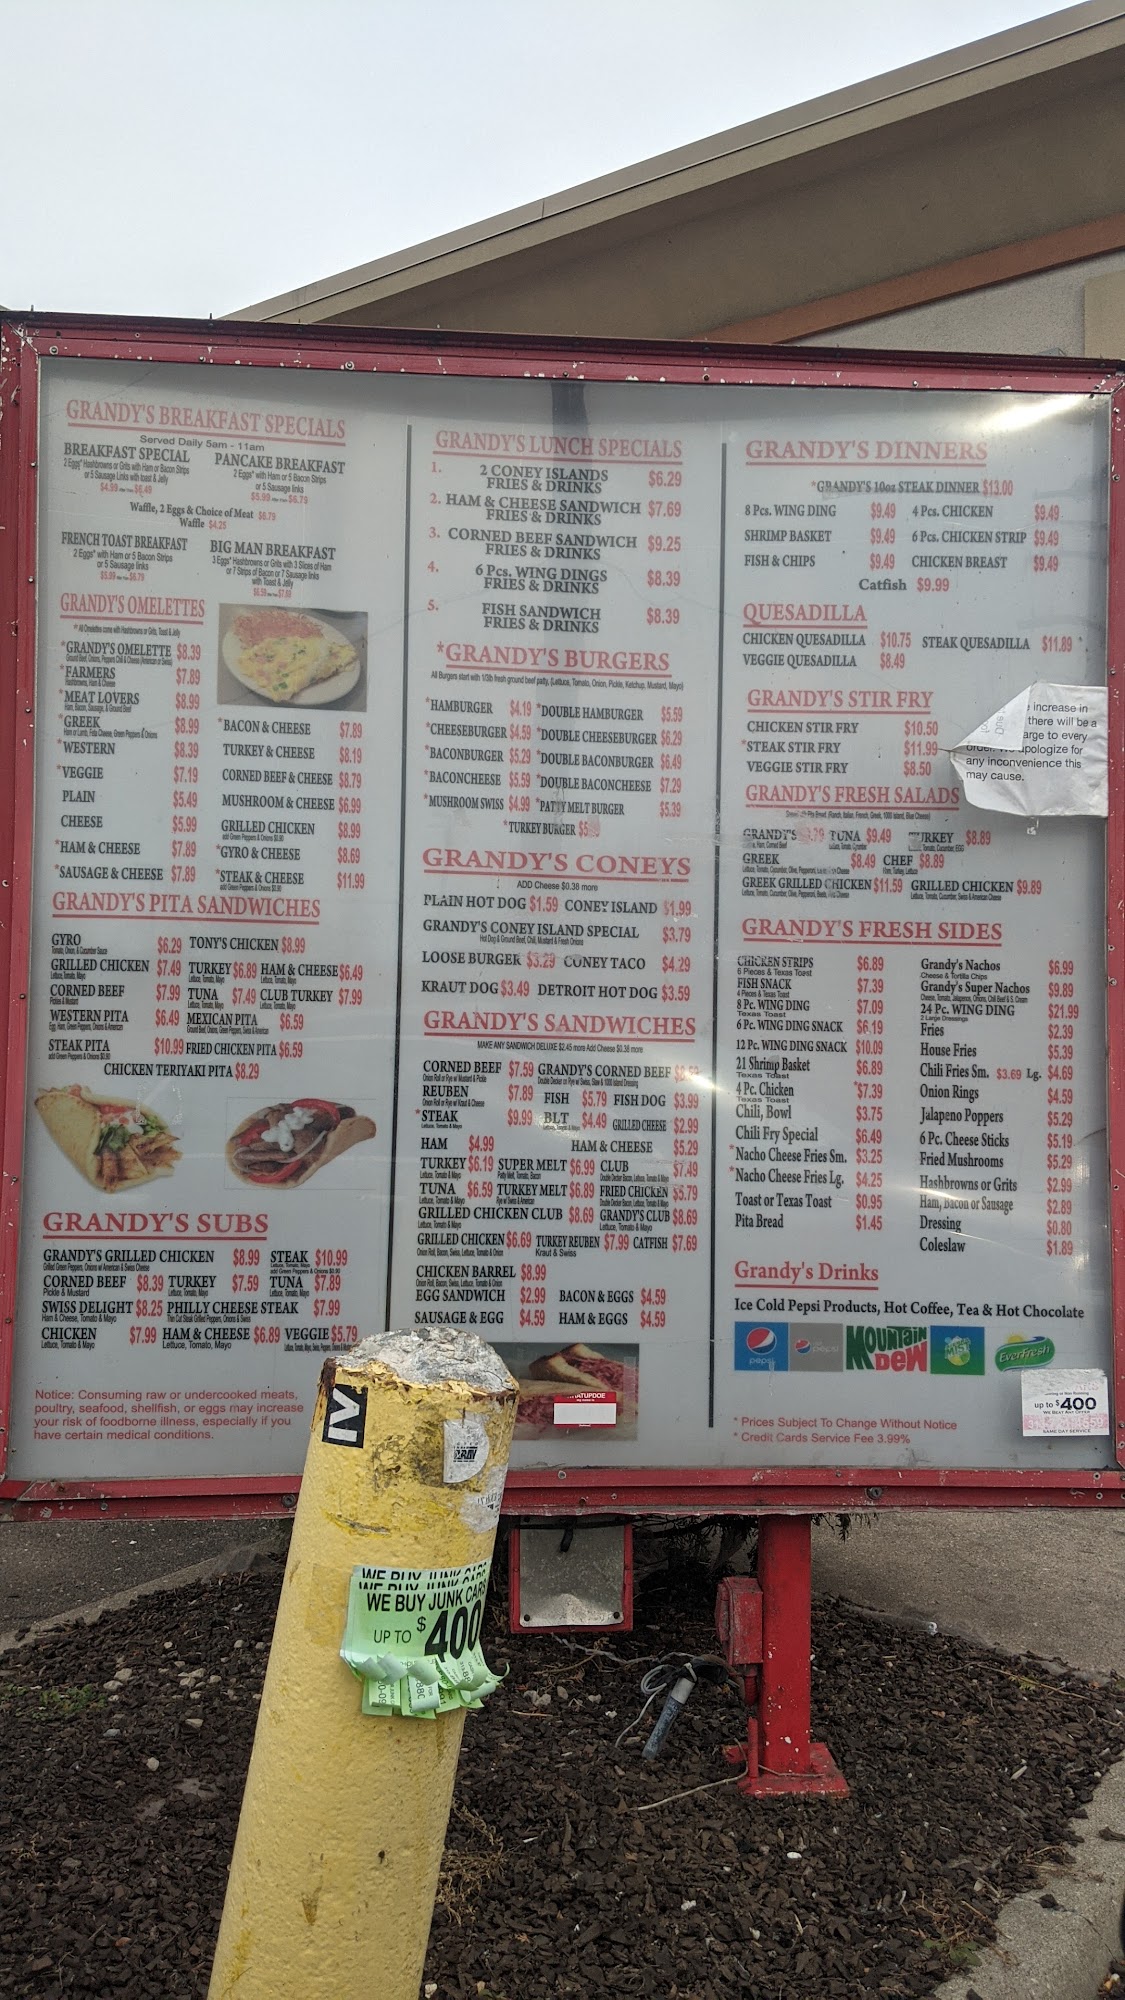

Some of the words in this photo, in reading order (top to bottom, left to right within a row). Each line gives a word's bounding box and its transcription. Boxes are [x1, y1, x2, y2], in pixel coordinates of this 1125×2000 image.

[66, 399, 155, 424] GRANDY'S
[159, 405, 262, 433] BREAKFAST
[265, 412, 346, 439] SPECIALS
[64, 442, 135, 460] BREAKFAST
[139, 447, 190, 464] SPECIAL
[435, 430, 526, 453] GRANDY'S
[530, 435, 594, 456] LUNCH
[598, 438, 683, 458] SPECIALS
[745, 440, 869, 460] GRANDY'S
[875, 441, 988, 461] DINNERS
[215, 452, 272, 470] PANCAKE
[276, 456, 346, 475] BREAKFAST
[480, 464, 488, 476] 2
[491, 464, 543, 479] CONEY
[546, 467, 609, 482] ISLANDS
[648, 469, 682, 488] $6.29
[445, 493, 481, 508] HAM
[485, 496, 495, 508] &
[498, 496, 557, 512] CHEESE
[559, 499, 641, 515] SANDWICH
[648, 500, 682, 518] $7.69
[744, 529, 787, 542] SHRIMP
[789, 529, 832, 542] BASKET
[870, 527, 896, 545] $9.49
[858, 578, 907, 591] Catfish
[917, 577, 950, 593] $9.99
[60, 592, 125, 615] GRANDY'S
[128, 595, 205, 618] OMELETTES
[743, 603, 867, 626] QUESADILLA
[922, 636, 958, 649] STEAK
[959, 637, 1030, 652] QUESADILLA
[1042, 635, 1073, 653] $11.89
[747, 689, 843, 708] GRANDY'S
[848, 690, 892, 709] STIR
[896, 691, 934, 709] FRY
[1033, 702, 1077, 713] increase
[1079, 704, 1088, 713] in
[747, 721, 803, 734] CHICKEN
[806, 722, 834, 734] STIR
[835, 722, 859, 734] FRY
[904, 720, 939, 737] $10.50
[1028, 716, 1054, 726] there
[1057, 716, 1074, 726] will
[1076, 718, 1089, 727] be
[1048, 731, 1058, 739] to
[1061, 732, 1088, 742] every
[223, 743, 265, 757] TURKEY
[266, 745, 274, 758] &
[275, 745, 315, 760] CHEESE
[339, 746, 362, 764] $8.19
[1071, 745, 1083, 755] for
[966, 757, 985, 767] any
[987, 757, 1062, 768] inconvenience
[1065, 759, 1081, 769] this
[966, 771, 988, 781] may
[990, 772, 1025, 782] cause.
[221, 819, 266, 833] GRILLED
[268, 821, 315, 836] CHICKEN
[338, 821, 361, 840] $8.99
[422, 848, 568, 872] GRANDY'S
[575, 854, 691, 876] CONEYS
[883, 854, 914, 867] CHEF
[919, 853, 944, 869] $8.89
[52, 891, 145, 913] GRANDY'S
[149, 894, 193, 914] PITA
[197, 895, 321, 918] SANDWICHES
[742, 918, 853, 938] GRANDY'S
[859, 920, 932, 939] FRESH
[937, 921, 1003, 940] SIDES
[189, 936, 228, 950] TONY'S
[229, 938, 279, 951] CHICKEN
[281, 936, 306, 954] $8.99
[921, 958, 963, 974] Grandy's
[964, 959, 1001, 971] Nachos
[1048, 960, 1074, 977] $6.99
[423, 1010, 539, 1033] GRANDY'S
[544, 1014, 696, 1036] SANDWICHES
[103, 1063, 154, 1077] CHICKEN
[156, 1064, 206, 1078] TERIYAKI
[208, 1065, 233, 1078] PITA
[235, 1062, 259, 1081] $8.29
[422, 1085, 469, 1098] REUBEN
[508, 1084, 534, 1103] $7.89
[735, 1125, 761, 1140] Chili
[763, 1126, 780, 1144] Fry
[782, 1127, 818, 1145] Special
[856, 1128, 882, 1145] $6.49
[418, 1207, 471, 1220] GRILLED
[473, 1207, 529, 1220] CHICKEN
[531, 1207, 563, 1220] CLUB
[568, 1206, 594, 1224] $8.69
[43, 1212, 189, 1233] GRANDY'S
[197, 1213, 269, 1234] SUBS
[920, 1237, 966, 1252] Coleslaw
[1046, 1239, 1073, 1257] $1.89
[734, 1261, 814, 1284] Grandy's
[819, 1263, 879, 1281] Drinks
[43, 1288, 61, 1297] Pickle
[66, 1288, 90, 1297] Mustard
[41, 1300, 77, 1314] SWISS
[78, 1301, 134, 1314] DELIGHT
[136, 1299, 163, 1318] $8.25
[167, 1302, 211, 1314] PHILLY
[212, 1302, 259, 1314] CHEESE
[260, 1302, 299, 1315] STEAK
[313, 1298, 341, 1318] $7.99
[734, 1298, 753, 1311] Ice
[756, 1298, 785, 1312] Cold
[788, 1299, 821, 1316] Pepsi
[823, 1299, 881, 1315] Products,
[884, 1301, 908, 1315] Hot
[910, 1301, 954, 1317] Coffee,
[957, 1303, 980, 1316] Tea
[982, 1304, 993, 1317] &
[995, 1304, 1020, 1317] Hot
[1023, 1304, 1085, 1318] Chocolate
[999, 1344, 1051, 1363] EverFresh
[35, 1389, 75, 1400] Notice:
[78, 1389, 143, 1402] Consuming
[145, 1392, 166, 1400] raw
[170, 1392, 181, 1400] or
[184, 1389, 257, 1400] undercooked
[260, 1390, 298, 1401] meats,
[1055, 1397, 1097, 1411] $400
[741, 1417, 775, 1429] Prices
[778, 1417, 816, 1431] Subject
[818, 1418, 832, 1429] To
[836, 1418, 878, 1432] Change
[880, 1418, 920, 1429] Without
[923, 1419, 957, 1430] Notice
[367, 1592, 391, 1612] WE
[395, 1593, 426, 1612] BUY
[428, 1588, 463, 1611] JUNK
[465, 1581, 487, 1604] CARS
[373, 1629, 391, 1644] UP
[394, 1630, 412, 1644] TO
